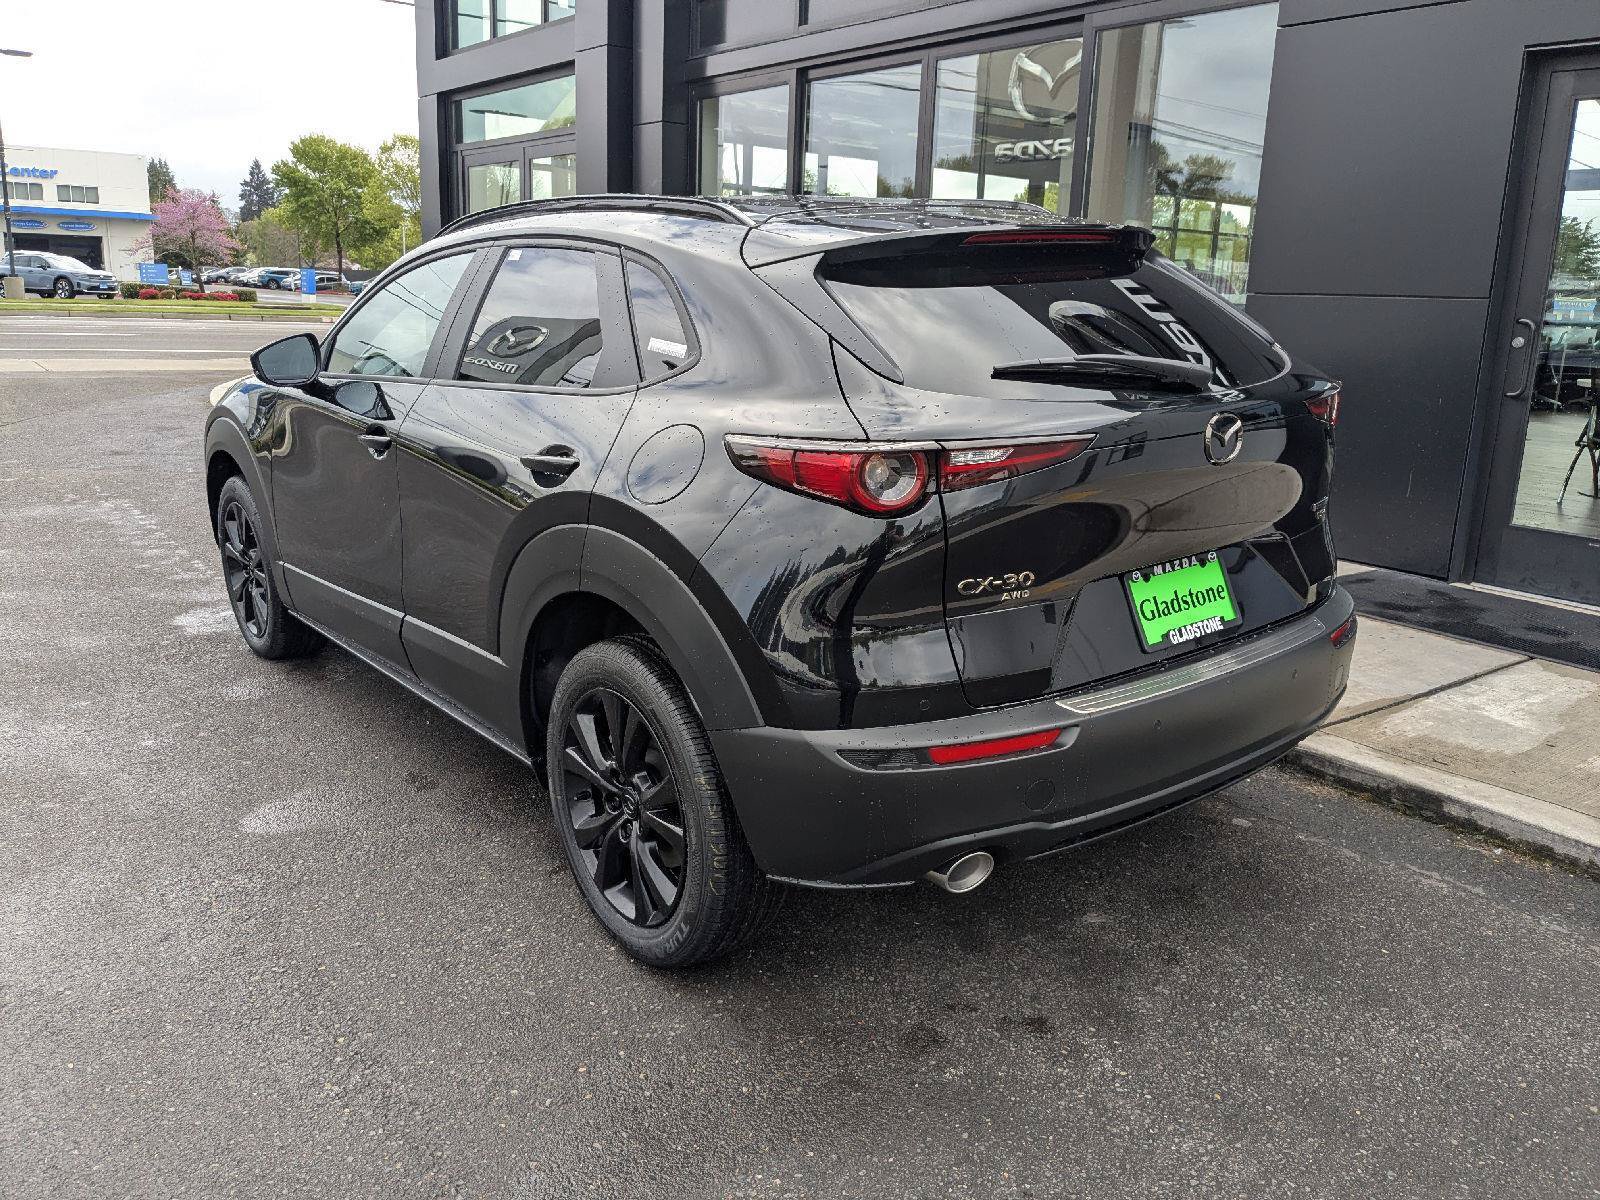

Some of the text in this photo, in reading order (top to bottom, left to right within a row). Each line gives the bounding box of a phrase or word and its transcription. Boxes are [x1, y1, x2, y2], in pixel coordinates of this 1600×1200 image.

[1153, 556, 1199, 575] MAZDA
[957, 571, 1035, 595] CX-30
[1000, 590, 1030, 601] AWD
[1140, 584, 1226, 622] Gladstone
[1169, 616, 1224, 644] GLADSTONE
